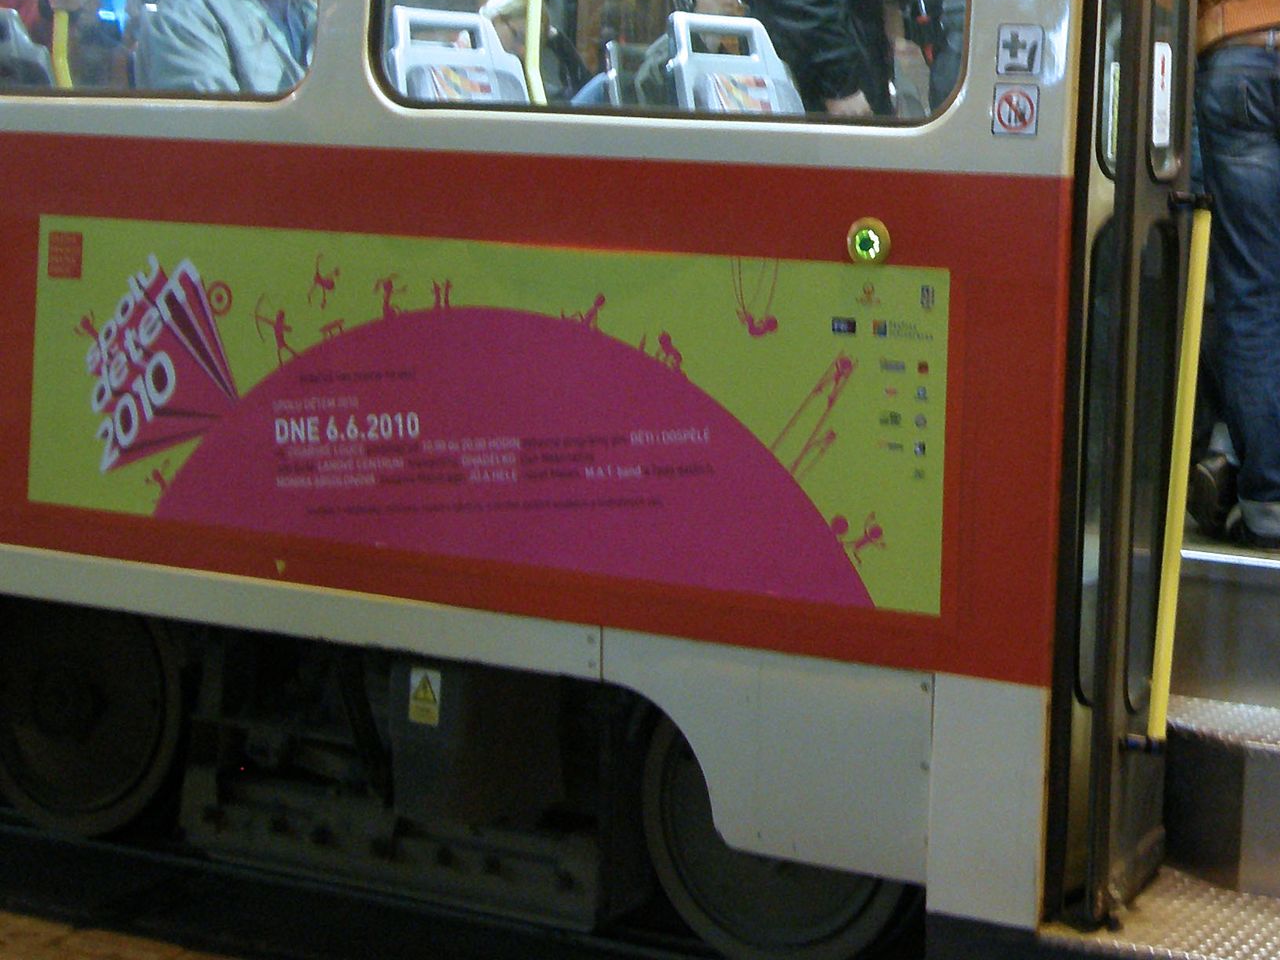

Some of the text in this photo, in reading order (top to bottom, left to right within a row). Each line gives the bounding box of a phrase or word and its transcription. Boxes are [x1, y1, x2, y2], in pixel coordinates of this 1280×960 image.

[96, 351, 176, 474] 2010
[274, 411, 420, 444] DNE 6.6.2010
